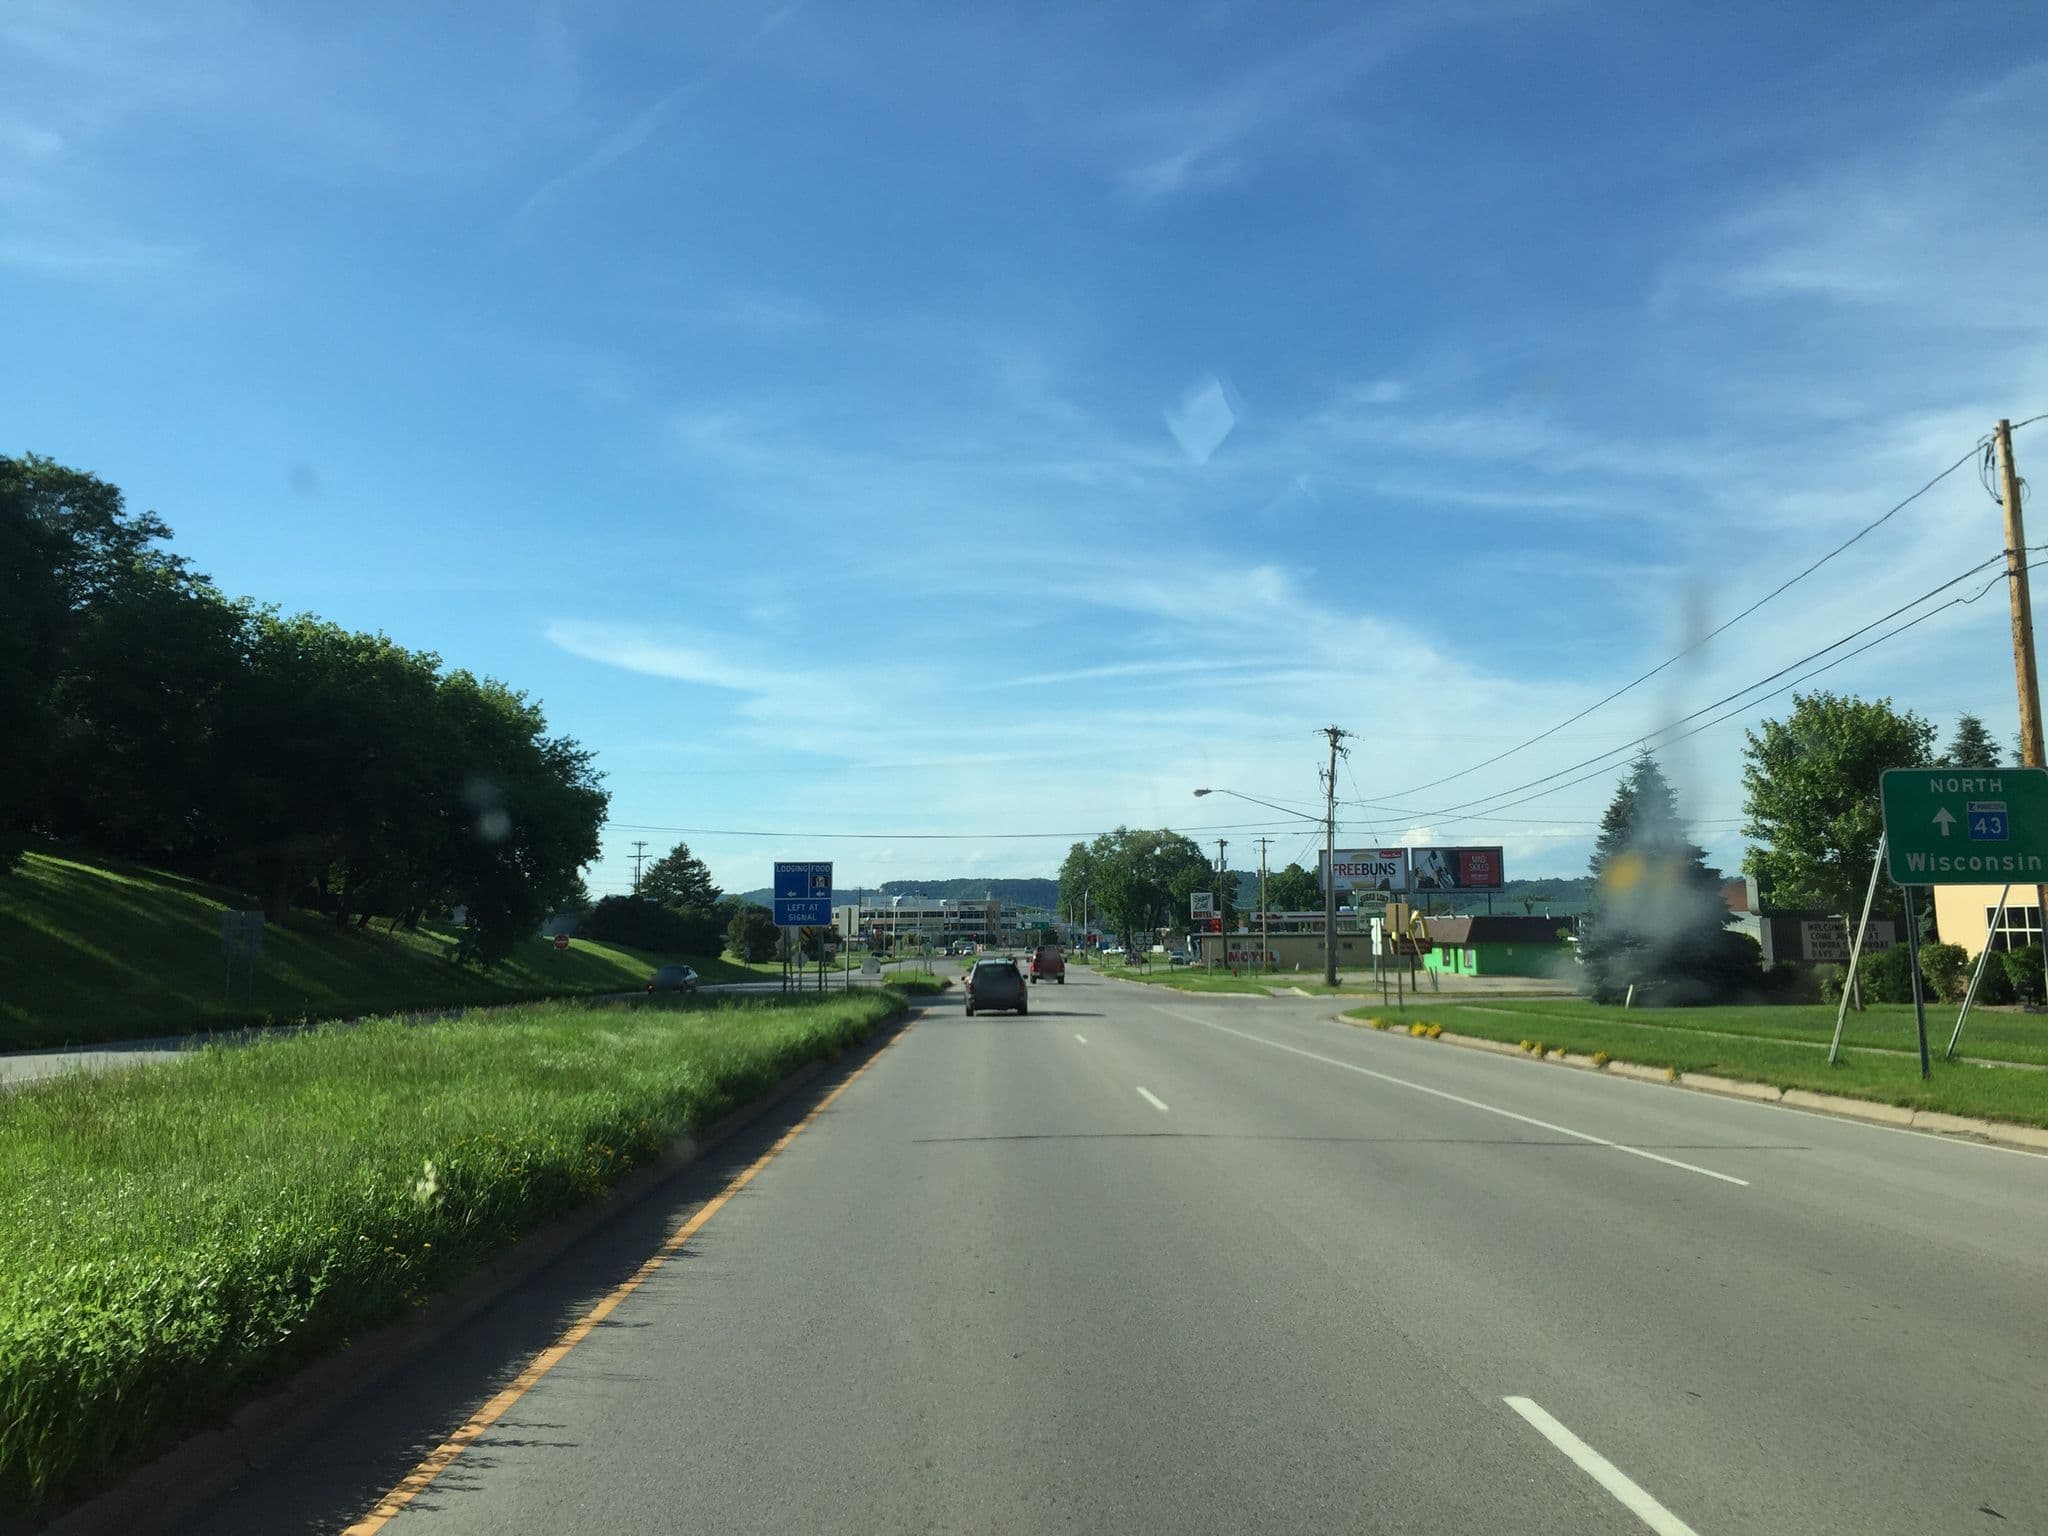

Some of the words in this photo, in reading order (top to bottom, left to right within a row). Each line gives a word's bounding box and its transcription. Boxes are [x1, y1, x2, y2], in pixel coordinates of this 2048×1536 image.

[1930, 778, 2003, 793] NORTH
[1974, 817, 2002, 834] 43
[1904, 852, 2042, 872] Wisconsin
[787, 903, 805, 912] LEFT
[808, 903, 819, 912] AT
[788, 913, 817, 922] SIGNAL
